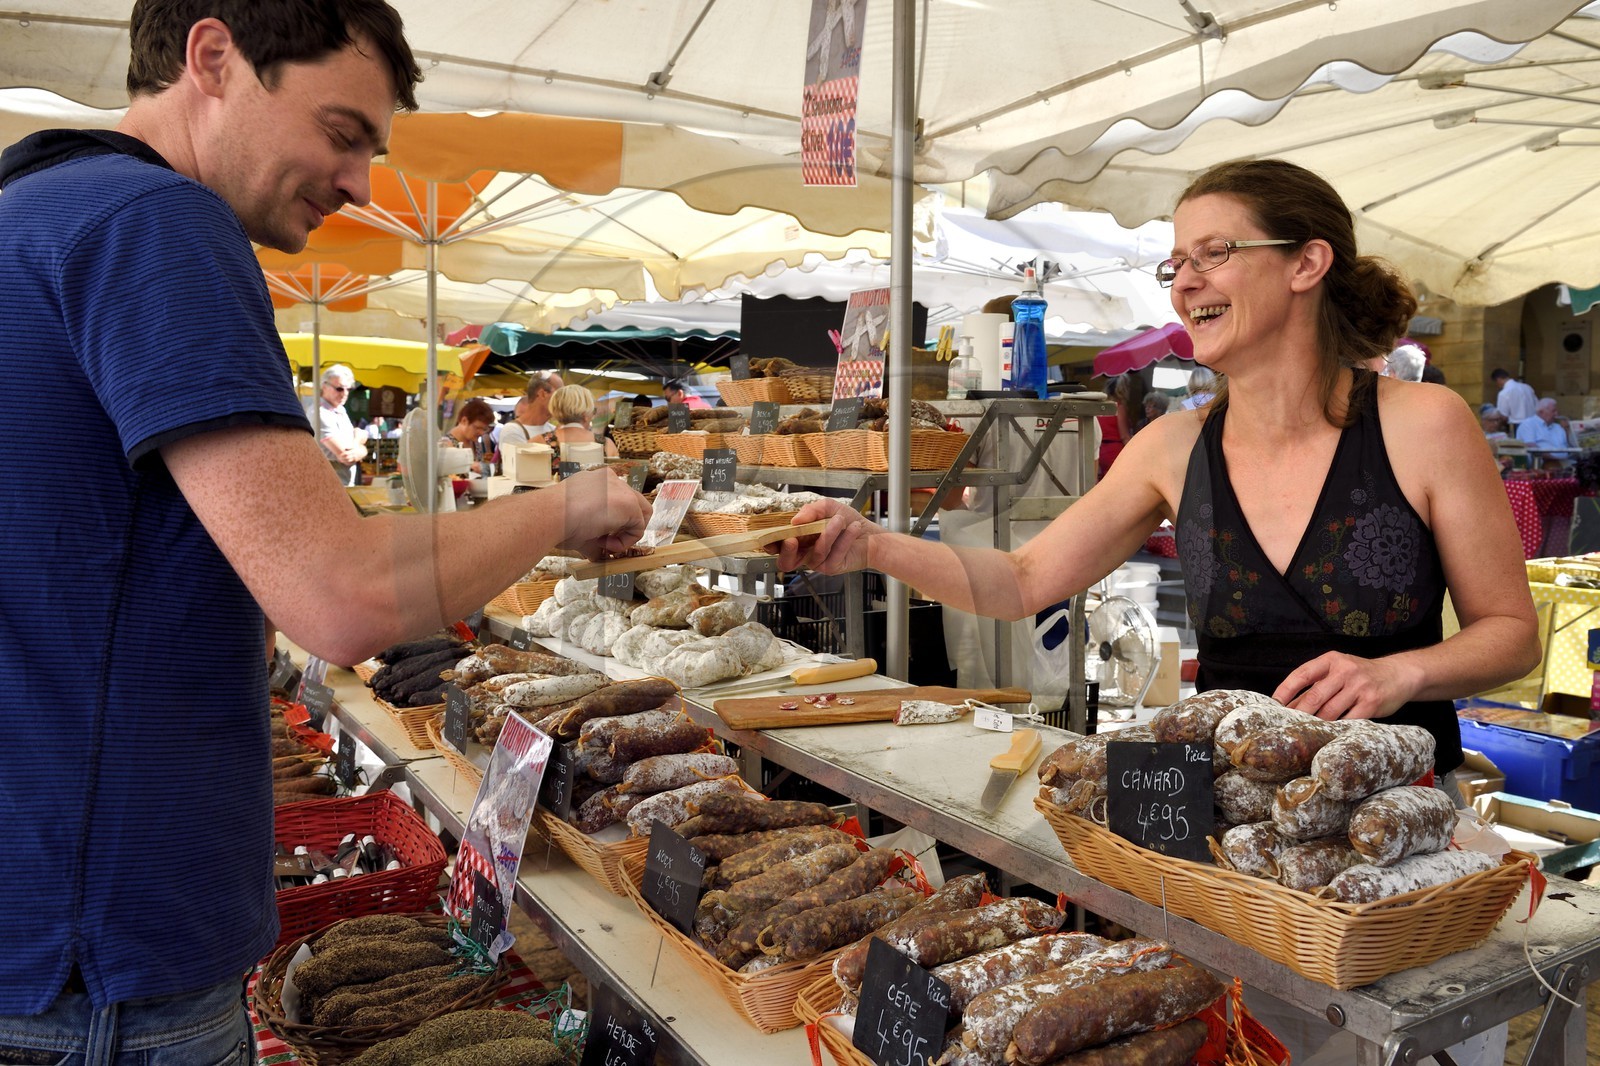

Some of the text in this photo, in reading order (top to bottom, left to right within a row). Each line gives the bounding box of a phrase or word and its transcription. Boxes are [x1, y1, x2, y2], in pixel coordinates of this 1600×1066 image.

[1184, 744, 1210, 762] Pièce
[1121, 767, 1185, 797] CANARD
[1137, 802, 1190, 840] 4€95
[656, 872, 682, 906] 4€95
[606, 1014, 642, 1056] HERBE
[877, 1008, 928, 1066] 4€95
